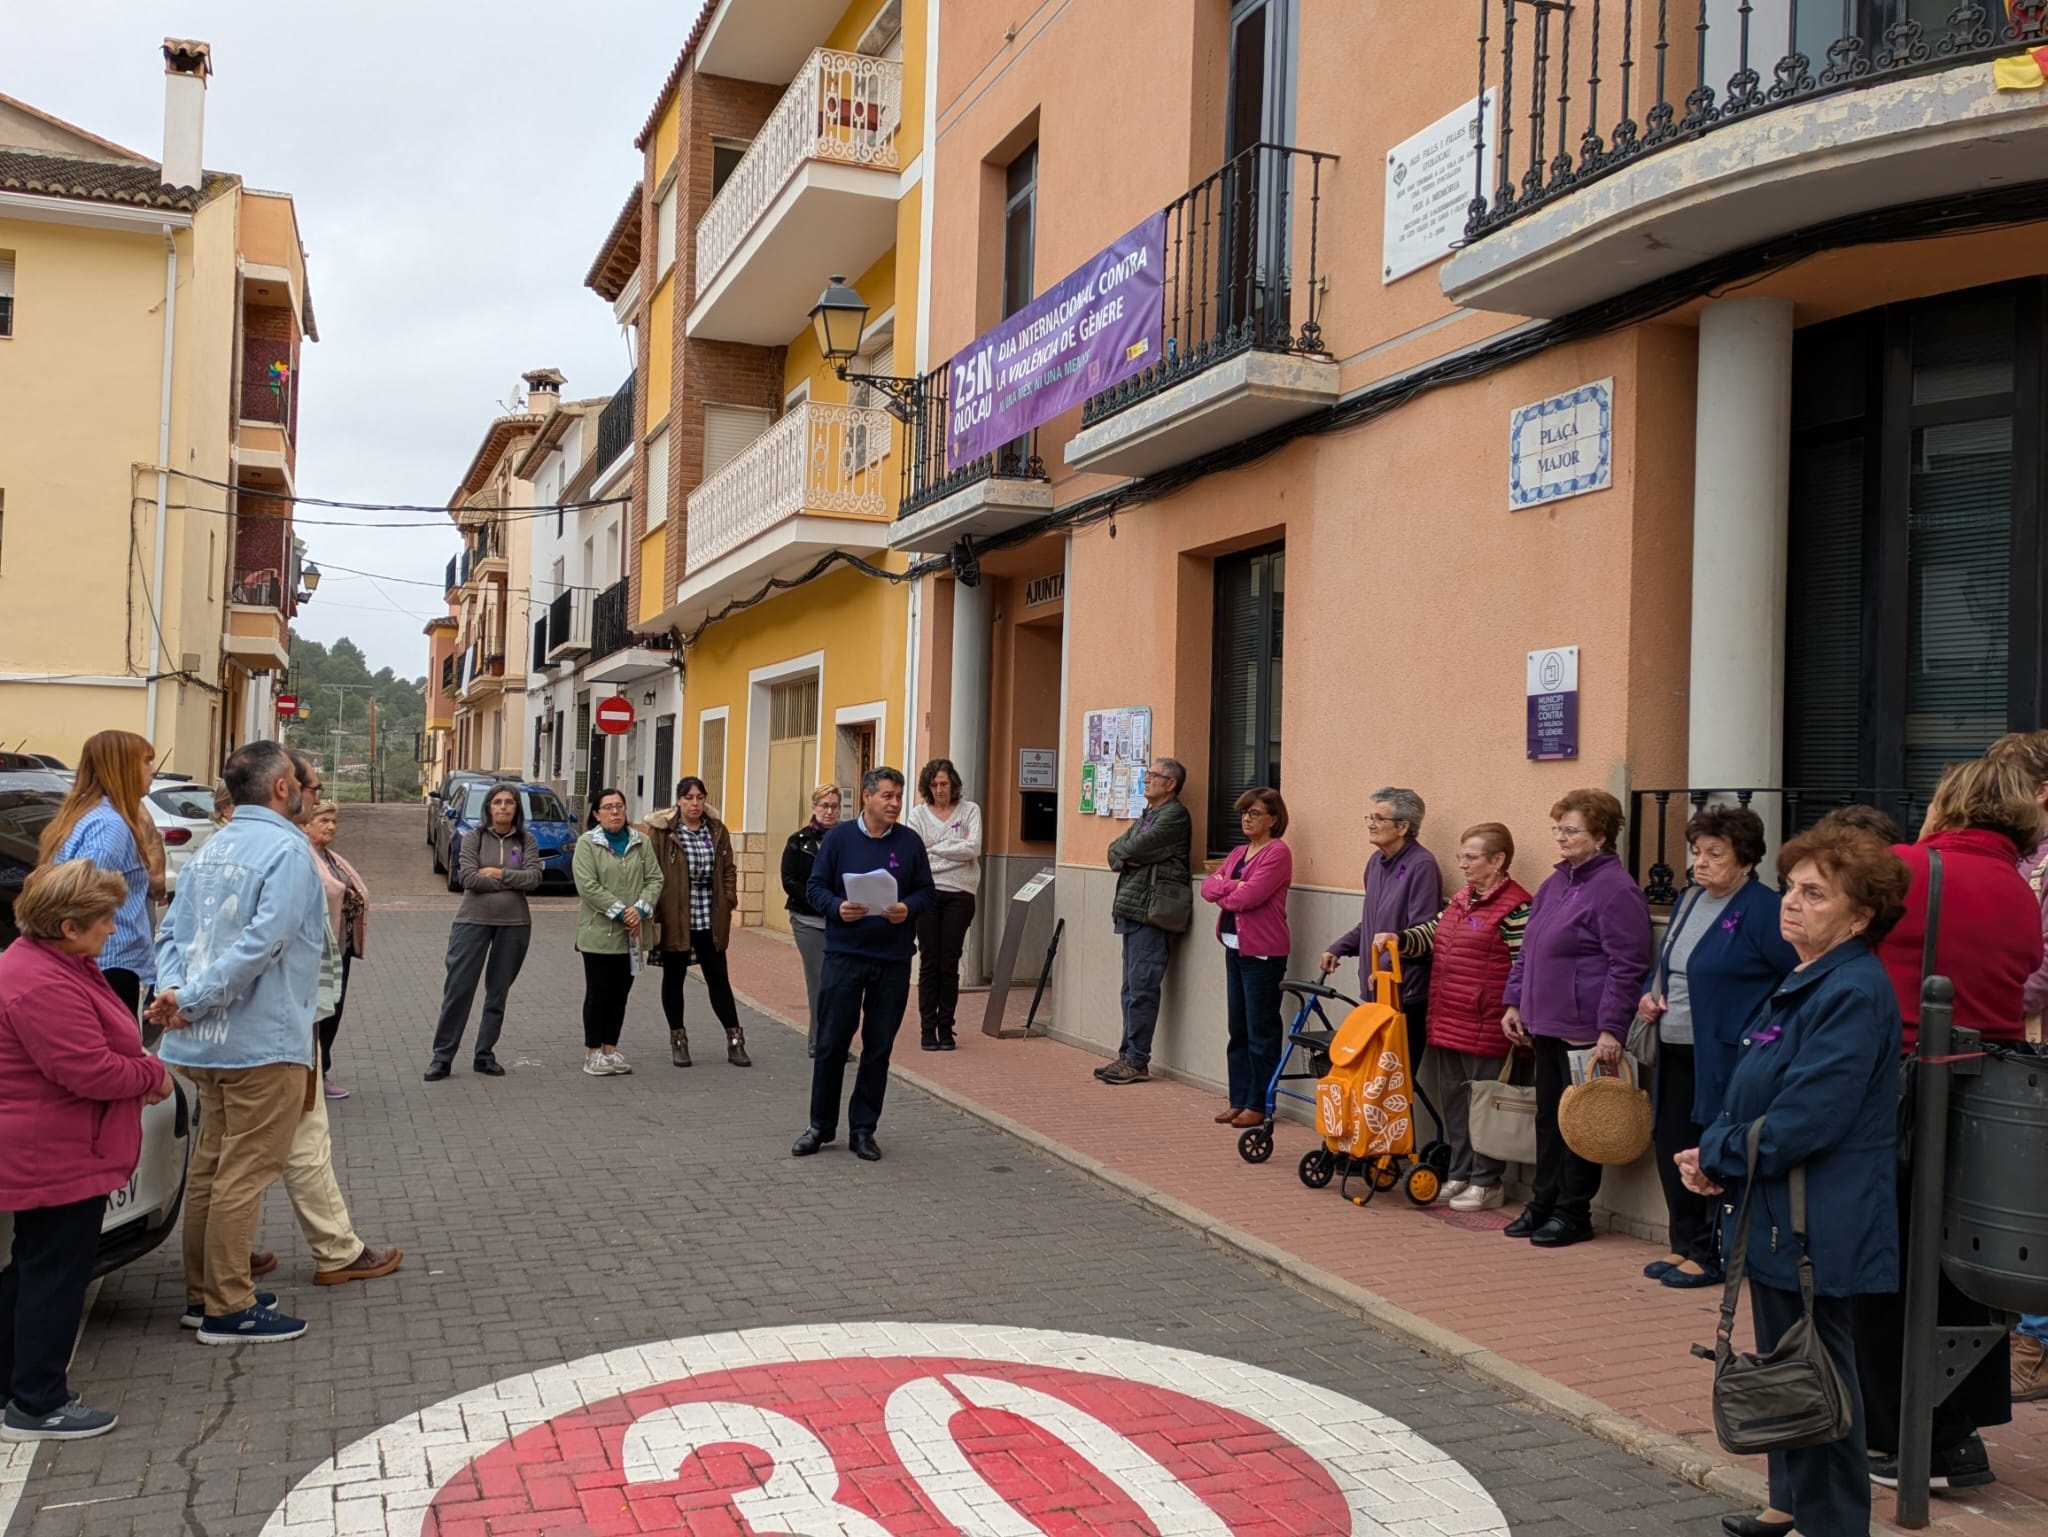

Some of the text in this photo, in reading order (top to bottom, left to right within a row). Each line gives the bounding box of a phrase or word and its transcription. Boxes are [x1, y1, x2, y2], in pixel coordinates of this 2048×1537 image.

[998, 336, 1017, 363] DIA
[1018, 281, 1096, 351] INTERNACIONAL
[1099, 246, 1148, 295] CONTRA
[996, 296, 1124, 392] LA VIOLÈNCIA DE GÈNERE
[955, 345, 993, 409] 25N
[1044, 366, 1062, 386] UNA
[954, 393, 992, 435] OLOCAU
[1540, 422, 1579, 446] PLAÇA
[1537, 450, 1580, 474] MAJOR
[1538, 711, 1564, 721] CONTRA
